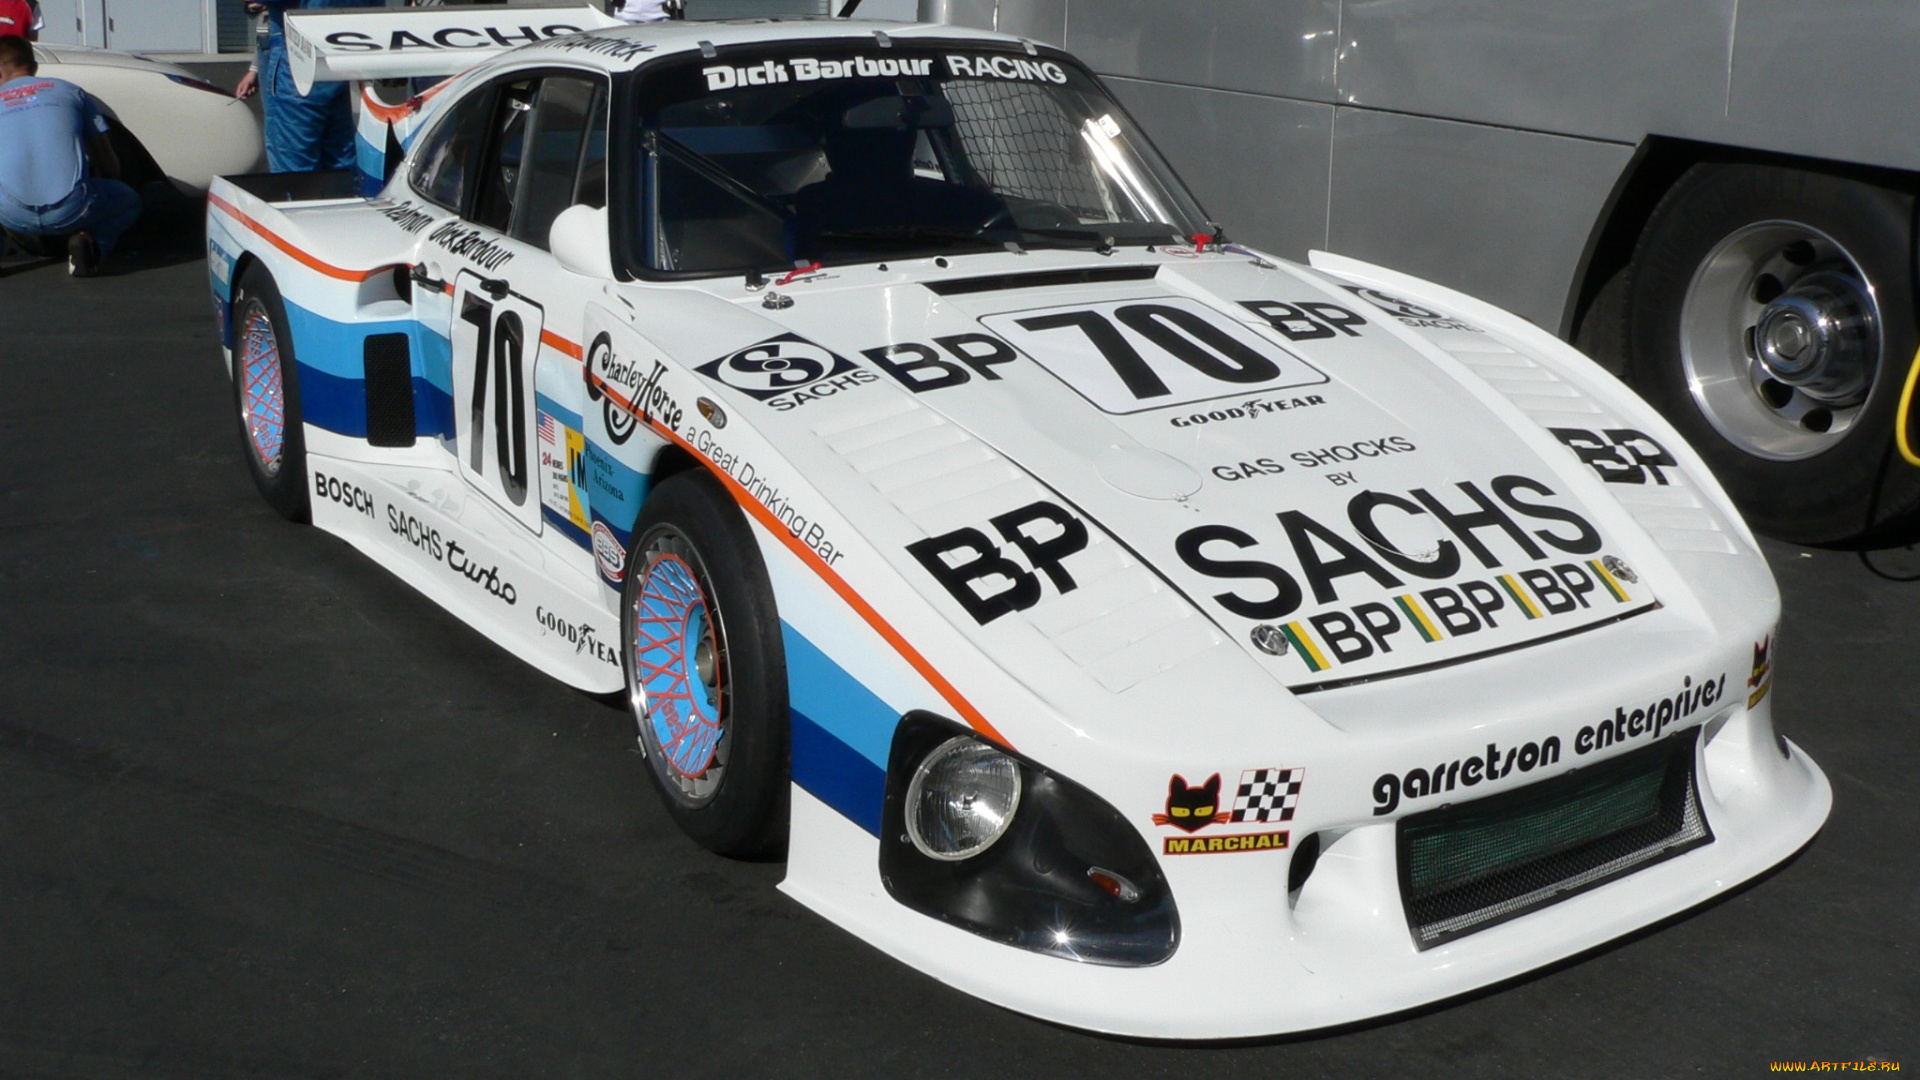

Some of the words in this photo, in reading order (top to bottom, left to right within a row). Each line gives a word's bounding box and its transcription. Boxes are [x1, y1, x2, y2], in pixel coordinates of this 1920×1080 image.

[702, 60, 789, 91] Dick
[789, 56, 933, 81] Barbour
[946, 55, 1067, 84] RACING
[428, 222, 468, 251] Dick
[450, 231, 515, 272] Barbour
[1234, 300, 1367, 341] BP
[1399, 318, 1485, 333] SACHS
[859, 333, 1017, 393] BP
[1012, 304, 1281, 400] 70
[460, 290, 527, 507] 70
[586, 330, 649, 445] Charley
[640, 359, 684, 431] Horse
[768, 370, 880, 412] SACHS
[1211, 458, 1285, 482] GAS
[1290, 436, 1416, 468] SHOCKS
[1325, 470, 1358, 487] BY
[1546, 427, 1678, 486] BP
[686, 426, 697, 445] a
[698, 430, 739, 475] Great
[738, 462, 808, 539] Drinking
[804, 522, 844, 566] Bar
[314, 471, 375, 519] BOSCH
[387, 503, 443, 561] SACHS
[445, 541, 517, 605] turbo
[904, 501, 1089, 627] BP
[1174, 474, 1602, 620] SACHS
[536, 605, 621, 667] GOODYEA
[1307, 601, 1401, 664] BP
[1419, 580, 1505, 637] BP
[1518, 563, 1595, 615] BP
[1373, 736, 1561, 816] garretson
[1574, 673, 1726, 755] enterprises
[1168, 834, 1284, 852] MARCHAL
